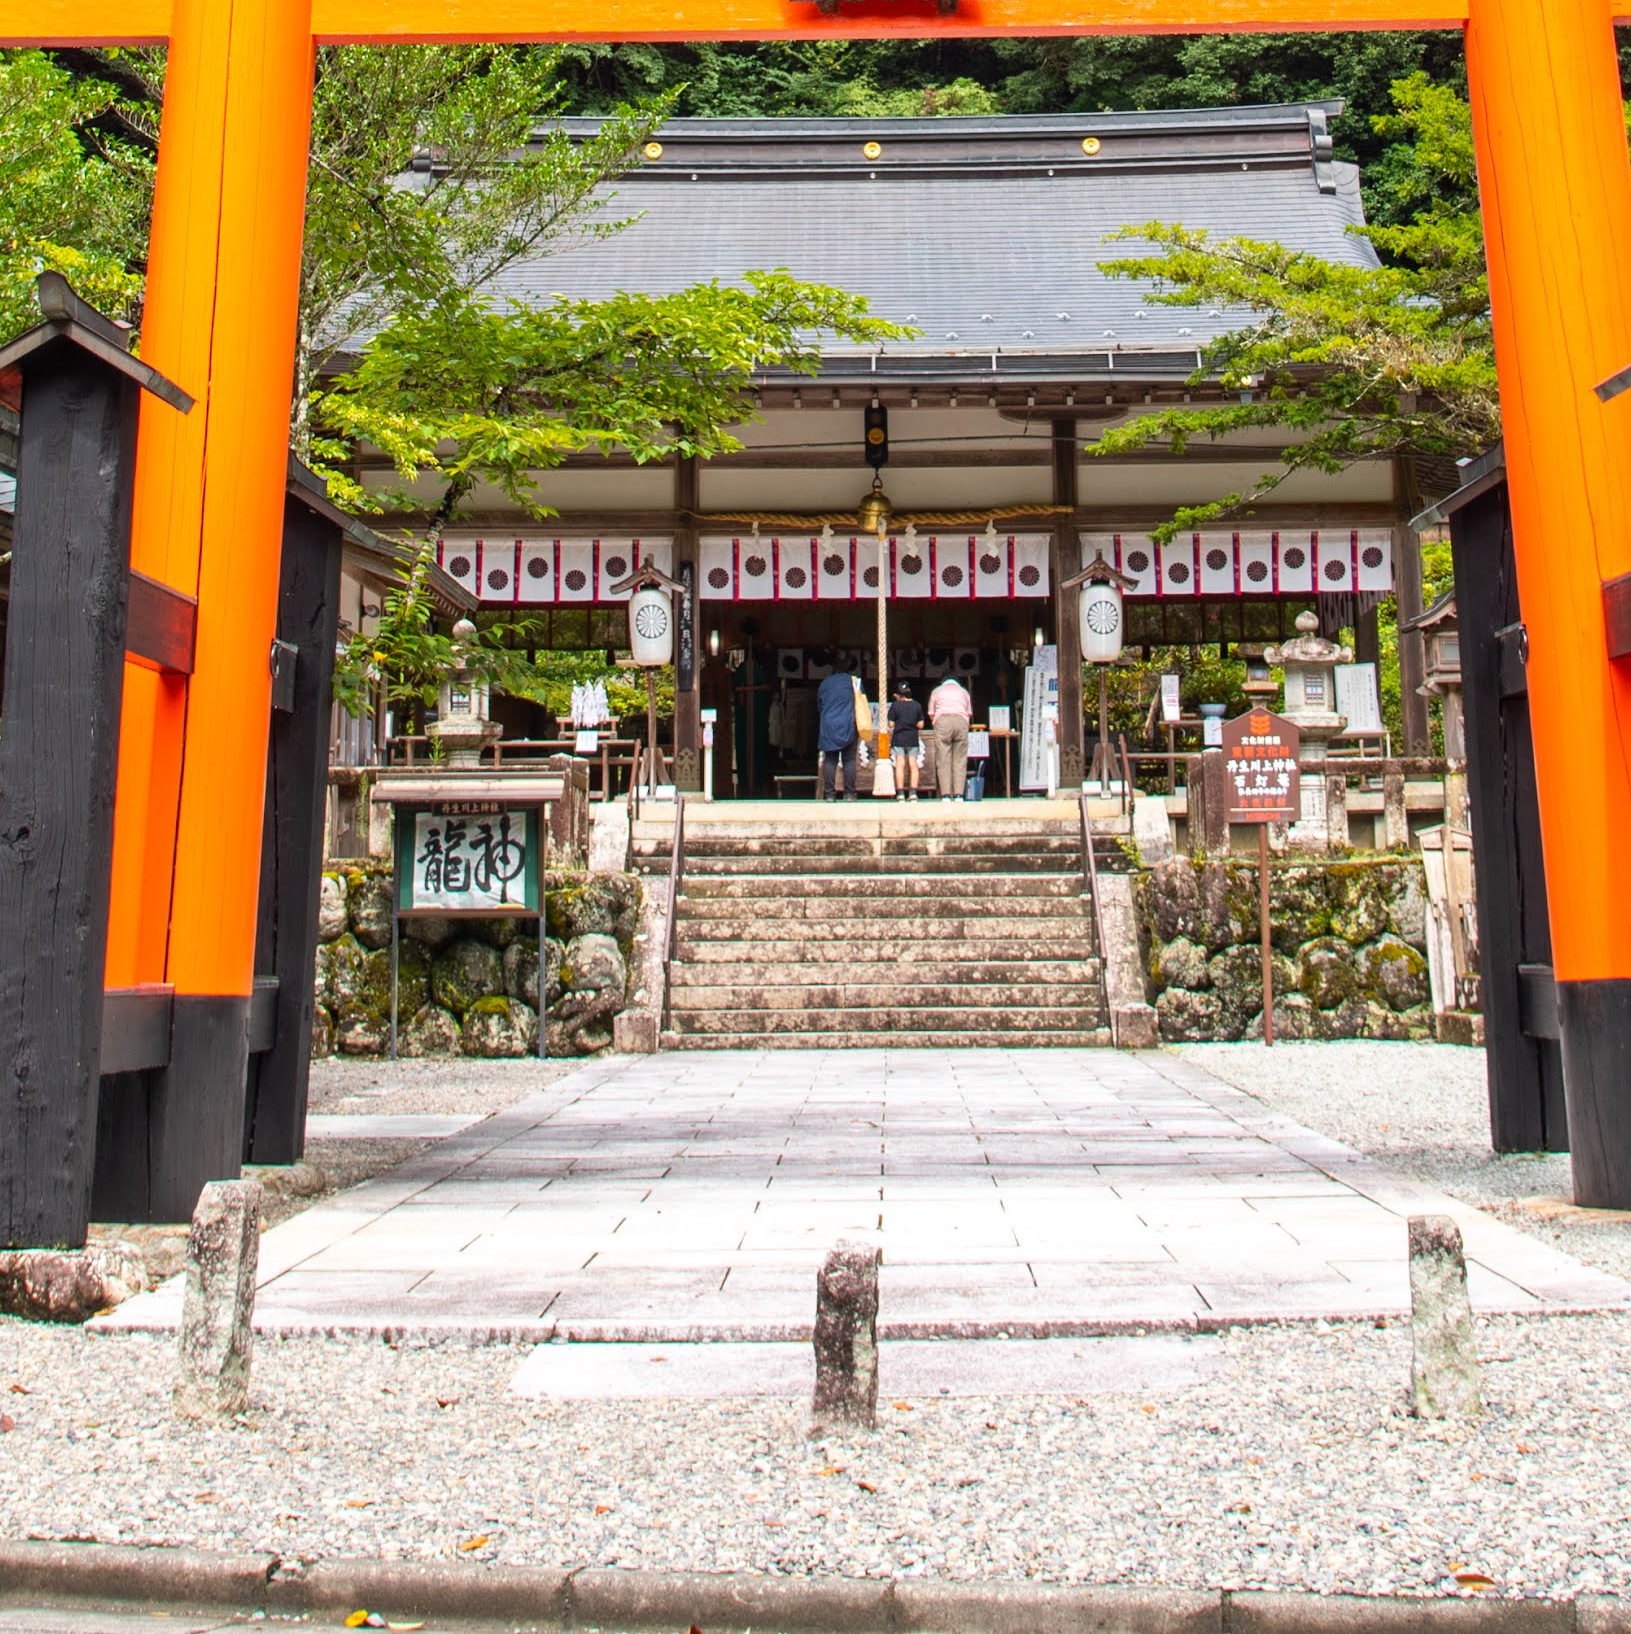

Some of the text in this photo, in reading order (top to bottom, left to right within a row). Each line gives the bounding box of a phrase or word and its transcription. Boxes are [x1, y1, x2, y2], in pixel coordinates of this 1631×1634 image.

[1226, 758, 1297, 773] 丹生川上神社
[441, 802, 500, 814] 丹生川上神社
[417, 815, 526, 904] 龍神
